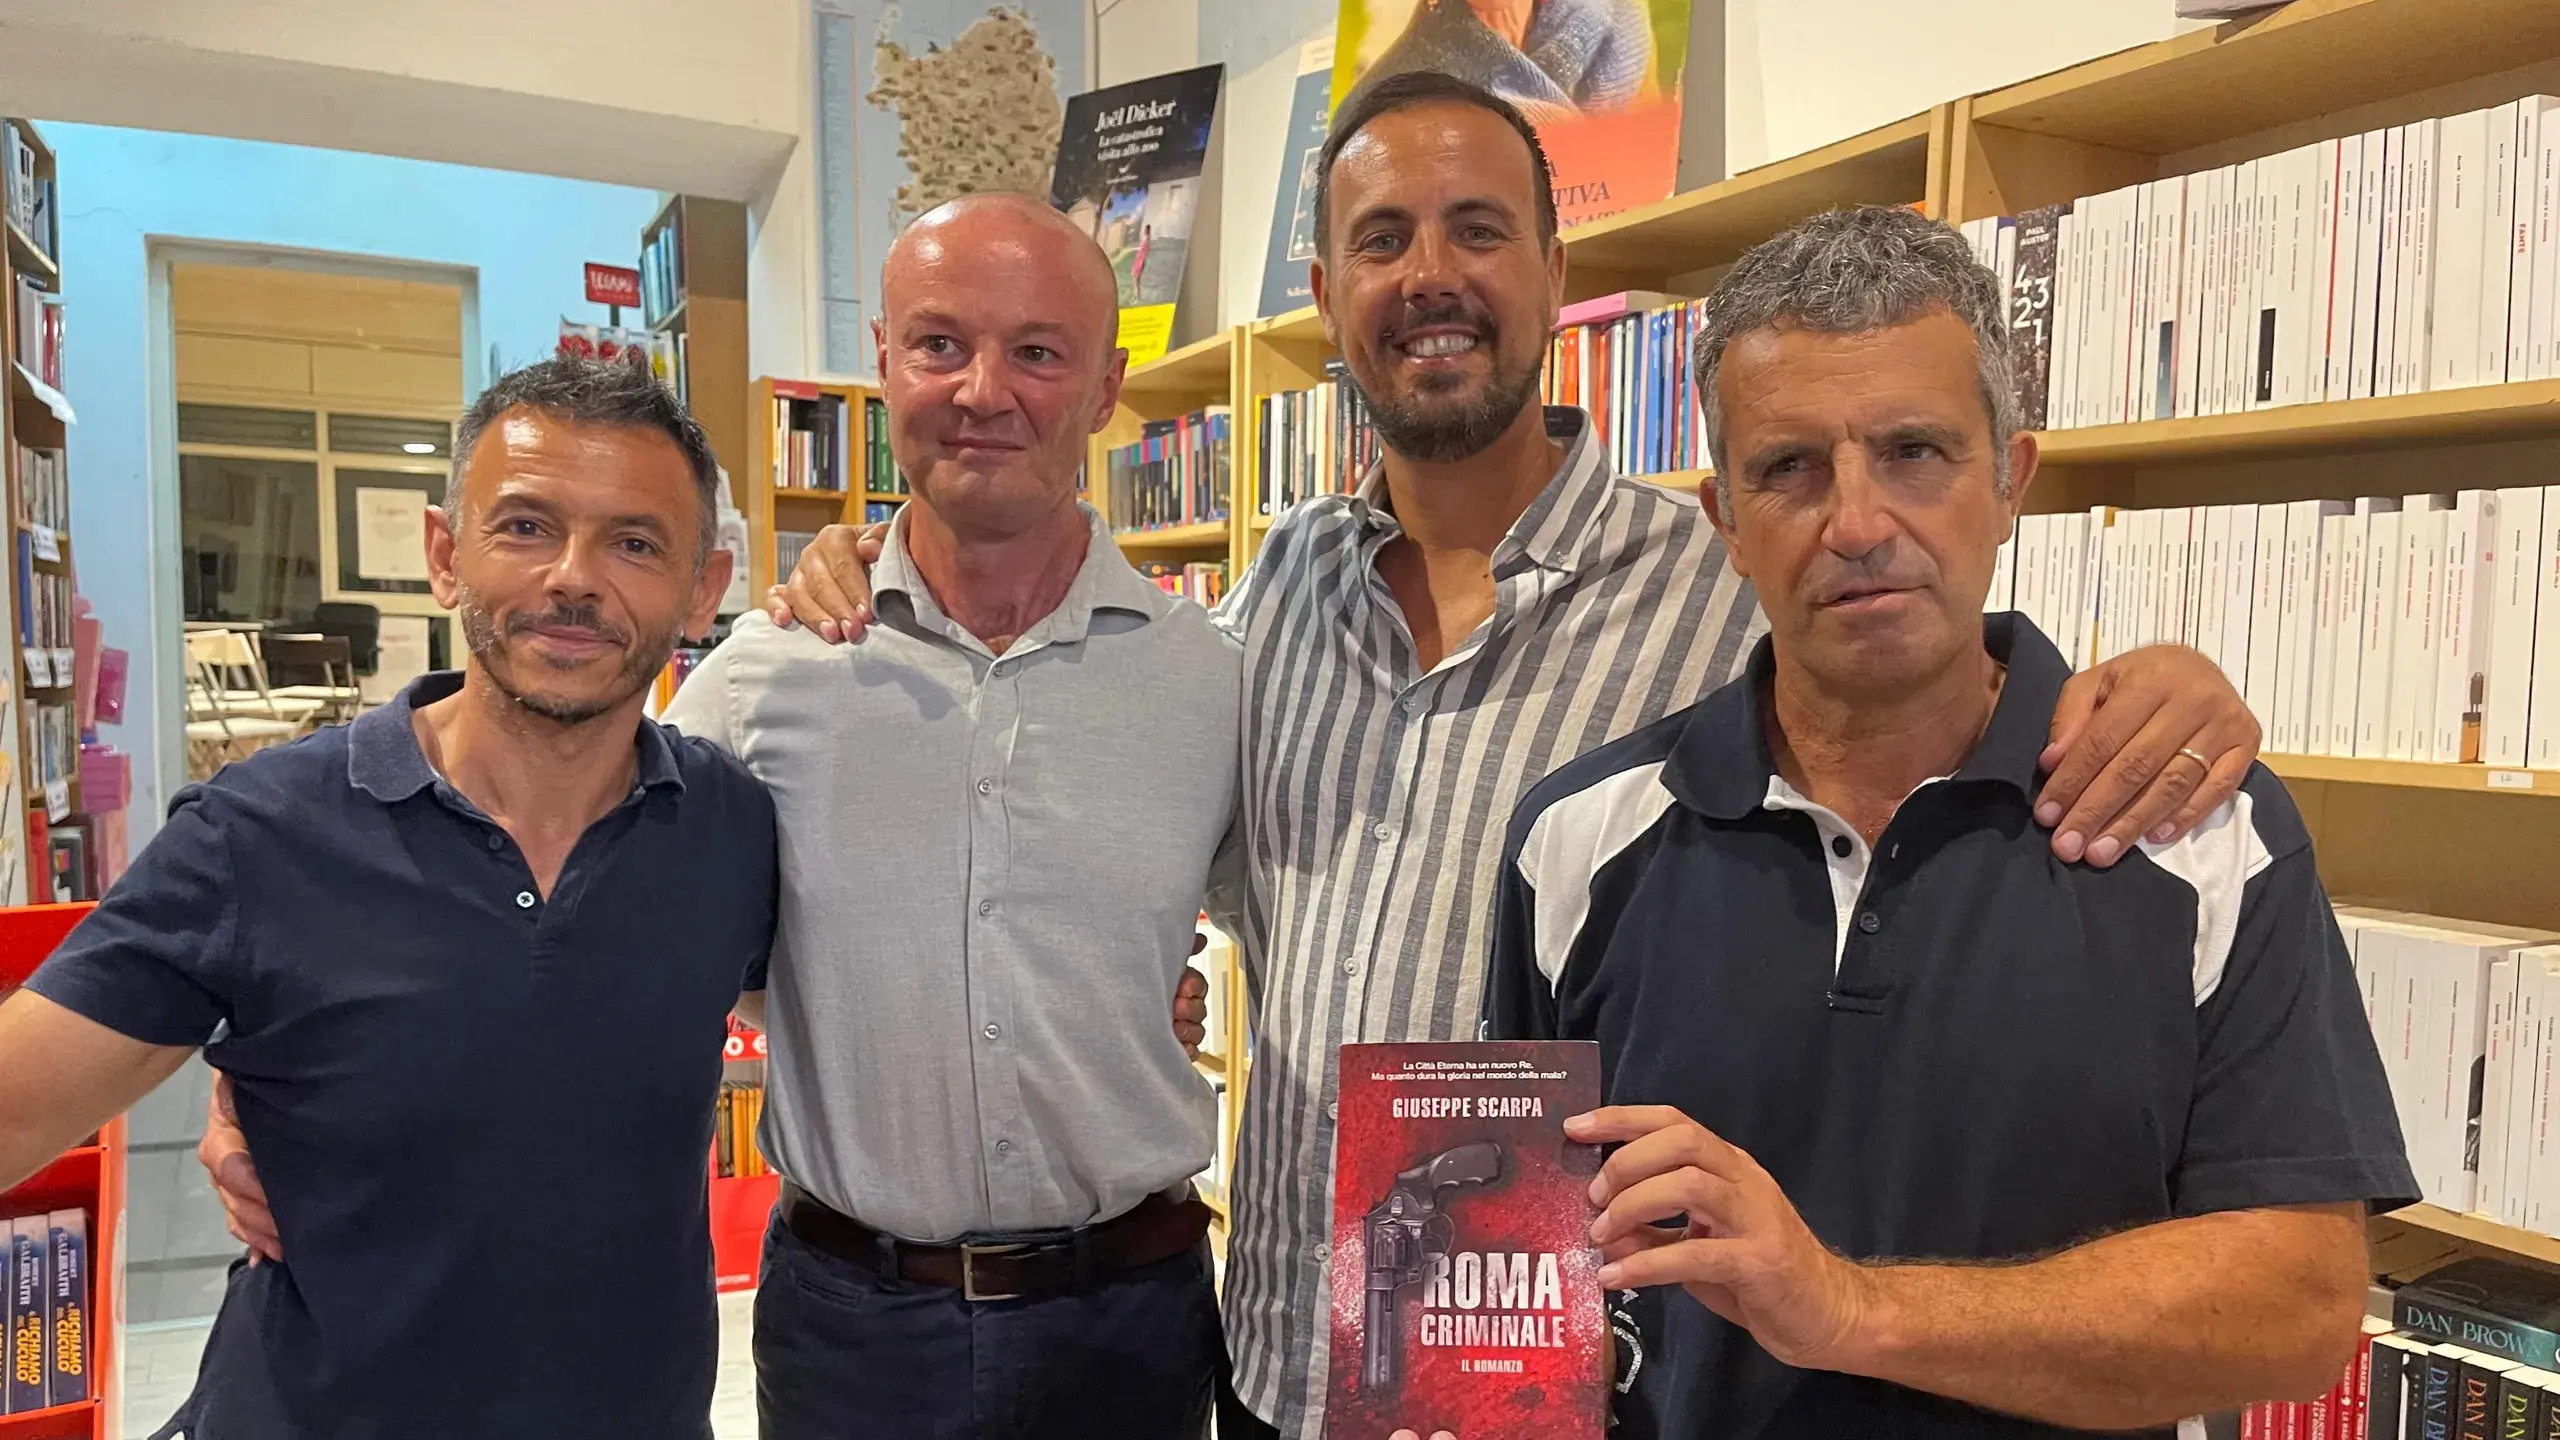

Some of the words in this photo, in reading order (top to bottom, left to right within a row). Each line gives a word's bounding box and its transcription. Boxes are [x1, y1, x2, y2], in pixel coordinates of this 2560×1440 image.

[1126, 99, 1177, 124] Dicker
[1371, 1073, 1385, 1081] Ma
[1386, 1073, 1415, 1082] quanto
[1417, 1072, 1436, 1080] dura
[1437, 1072, 1446, 1080] la
[1447, 1072, 1471, 1082] gloria
[1472, 1072, 1485, 1080] nel
[1486, 1072, 1517, 1080] mondo
[1518, 1072, 1539, 1080] della
[1541, 1071, 1567, 1080] mala?
[1403, 1062, 1414, 1070] La
[1415, 1061, 1435, 1070] Città
[1437, 1062, 1464, 1070] Eterna
[1519, 1061, 1534, 1069] Re.
[1392, 1098, 1471, 1118] GIUSEPPE
[1477, 1097, 1543, 1118] SCARPA
[1423, 1251, 1564, 1310] ROMA
[1420, 1313, 1565, 1348] CRIMINALE
[2407, 1306, 2453, 1335] DAN
[2462, 1321, 2541, 1358] BROWN
[1461, 1359, 1472, 1373] IL
[1474, 1359, 1523, 1373] ROMANZO
[2428, 1367, 2449, 1415] DAN
[2465, 1378, 2487, 1427] DAN
